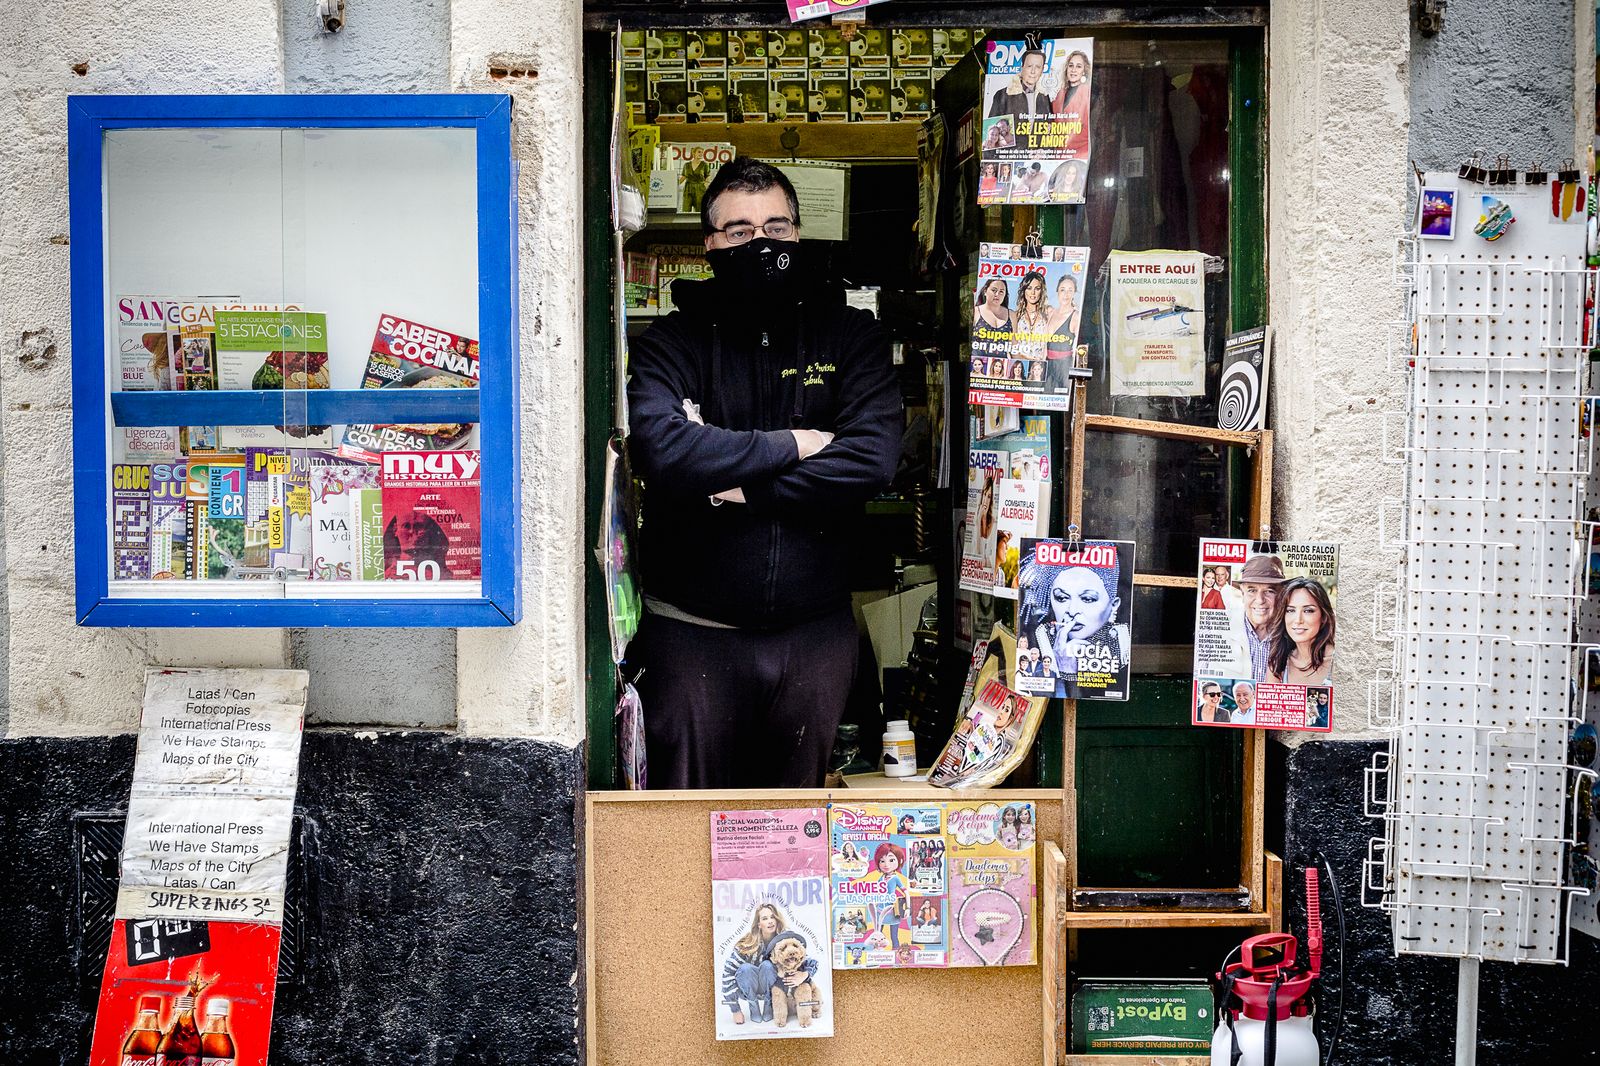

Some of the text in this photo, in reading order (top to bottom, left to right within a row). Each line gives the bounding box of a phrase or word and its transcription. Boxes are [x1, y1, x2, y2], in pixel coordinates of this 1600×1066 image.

[1016, 118, 1082, 134] ¿SE LES ROMPIÓ
[1028, 136, 1070, 148] EL AMOR?
[978, 262, 1047, 278] pronto
[1120, 263, 1195, 274] ENTRE AQUÍ
[220, 324, 322, 338] 5 ESTACIONES
[380, 317, 452, 352] SABER
[972, 342, 1031, 355] en peligro
[388, 338, 479, 380] COCINAR
[122, 372, 144, 380] BLUE
[368, 368, 402, 382] CASEROS
[378, 363, 405, 376] GUISOS
[126, 428, 166, 440] Ligereza
[348, 431, 382, 450] CON
[352, 424, 374, 436] MIL
[382, 428, 426, 450] IDEAS
[270, 456, 288, 464] NIVEL
[383, 454, 478, 478] muy
[969, 452, 998, 469] SABER
[273, 464, 286, 472] 1-2
[114, 466, 150, 490] CRUC
[223, 470, 240, 492] 1
[212, 470, 221, 516] CONTIENE
[222, 494, 244, 516] CR
[1026, 500, 1034, 508] LAS
[436, 514, 464, 523] GOYA
[1001, 508, 1034, 520] ALERGIAS
[271, 510, 280, 545] LÓGICA
[332, 534, 338, 542] y
[363, 520, 372, 570] naturales
[1206, 544, 1244, 558] ¡HOLA!
[1282, 544, 1334, 554] CARLOS FALCÓ
[396, 560, 440, 580] 50
[1066, 642, 1111, 658] LUCÍA
[1078, 656, 1120, 672] BOSÉ
[188, 688, 220, 700] Latas
[232, 689, 256, 700] Can
[186, 703, 250, 716] Fotocopias
[160, 717, 272, 732] International Press
[162, 734, 182, 746] We
[186, 736, 216, 747] Have
[162, 752, 260, 766] Maps of the City
[947, 811, 1000, 824] Diademas
[148, 822, 264, 835] International Press
[966, 821, 988, 832] clips
[149, 840, 258, 856] We Have Stamps
[150, 860, 252, 874] Maps of the City
[965, 860, 1008, 872] Diademas
[164, 877, 198, 888] Latas
[210, 878, 236, 890] Can
[974, 872, 996, 886] clips
[716, 879, 822, 910] GLAMOUR
[846, 894, 896, 903] LAS CHICAS
[148, 892, 248, 912] SUPERZINGS
[1116, 1003, 1186, 1020] ByPost
